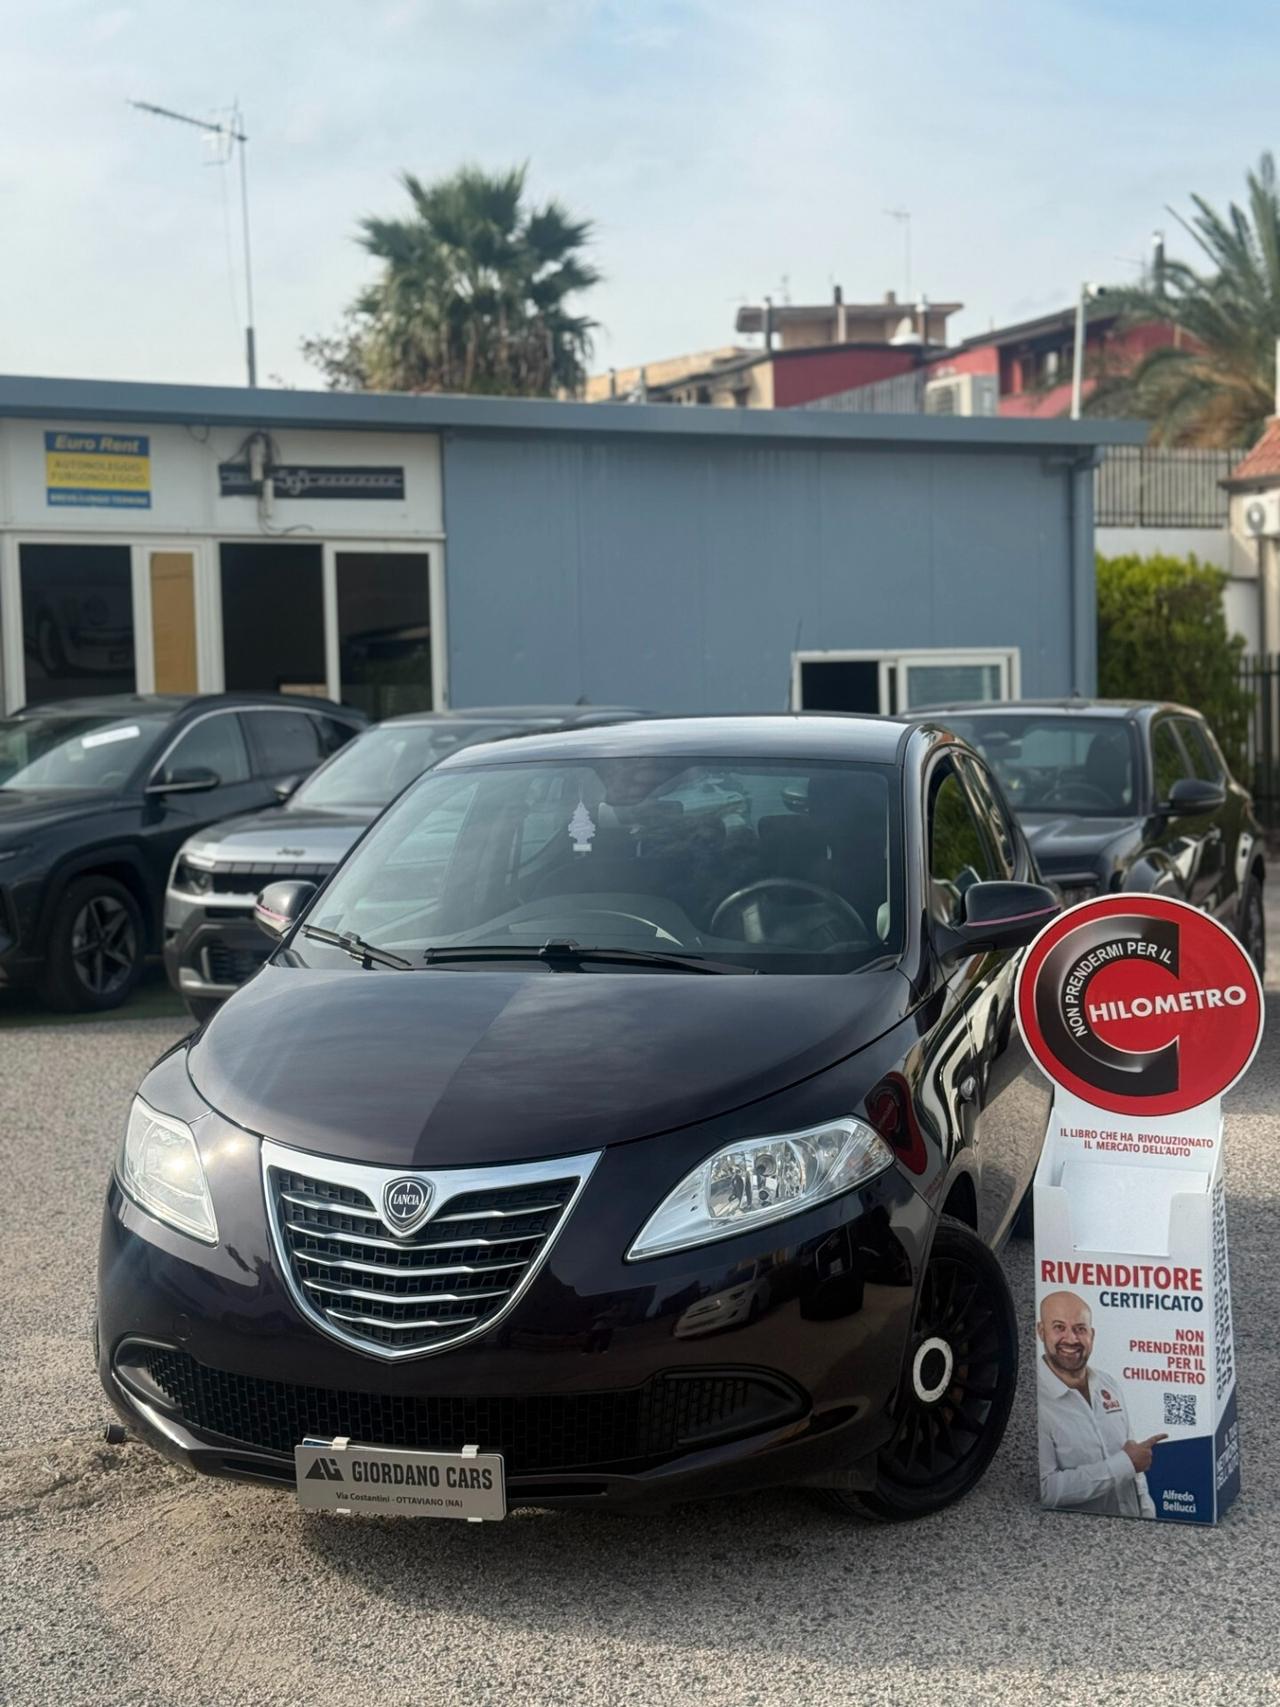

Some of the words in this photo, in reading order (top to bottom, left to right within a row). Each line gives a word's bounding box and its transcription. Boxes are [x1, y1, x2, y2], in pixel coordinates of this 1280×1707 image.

[55, 434, 96, 449] Euro
[99, 436, 140, 452] Rent
[1127, 941, 1157, 957] PER
[1160, 948, 1173, 964] IL
[1065, 943, 1124, 1002] PRENDERMI
[1065, 1009, 1088, 1037] NON
[1060, 1128, 1069, 1138] IL
[1071, 1129, 1098, 1140] LIBRO
[1100, 1131, 1118, 1141] CHE
[1120, 1132, 1134, 1142] HA
[1138, 1134, 1214, 1148] RIVOLUZIONATO
[1084, 1141, 1094, 1150] IL
[1096, 1142, 1140, 1154] MERCATO
[1142, 1145, 1191, 1157] DELL'AUTO
[393, 1194, 420, 1206] LANCIA
[1040, 1260, 1203, 1291] RIVENDITORE
[1099, 1291, 1204, 1312] CERTIFICATO
[1175, 1329, 1205, 1343] NON
[1129, 1340, 1205, 1356] PRENDERMI
[1167, 1356, 1191, 1370] PER
[1194, 1357, 1206, 1371] IL
[1123, 1367, 1206, 1385] CHILOMETRO
[352, 1461, 440, 1487] GIORDANO
[446, 1466, 493, 1490] CARS
[336, 1491, 348, 1500] Via
[350, 1492, 390, 1504] Costantini
[396, 1496, 443, 1506] OTTAVIANO
[445, 1499, 463, 1508] (NA)
[1162, 1489, 1194, 1502] Alfredo
[1163, 1501, 1196, 1514] Bellucci
